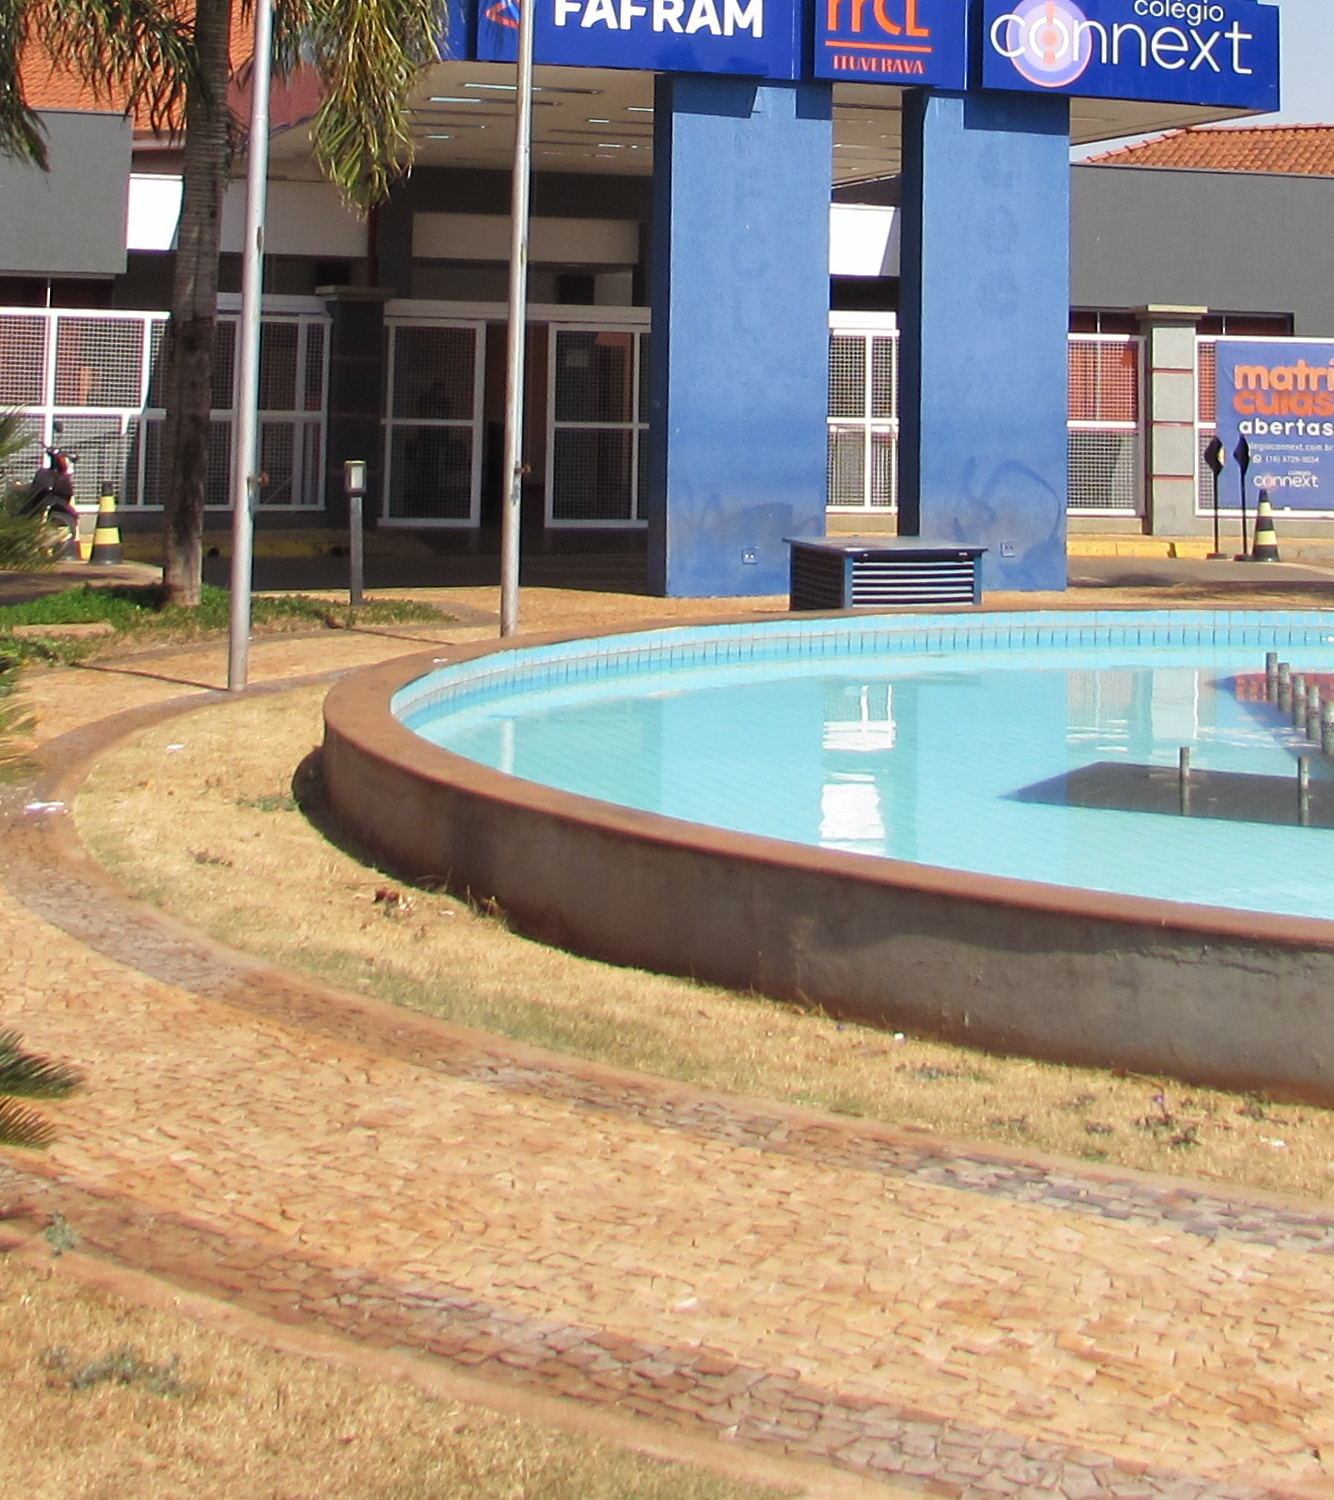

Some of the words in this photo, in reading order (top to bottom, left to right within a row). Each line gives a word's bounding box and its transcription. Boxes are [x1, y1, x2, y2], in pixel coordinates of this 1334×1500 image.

[990, 13, 1253, 74] connext
[833, 55, 925, 74] ITUVERAVA
[1239, 418, 1334, 436] abertas
[1249, 441, 1334, 452] legioconnext.com.br
[1253, 474, 1319, 488] connext
